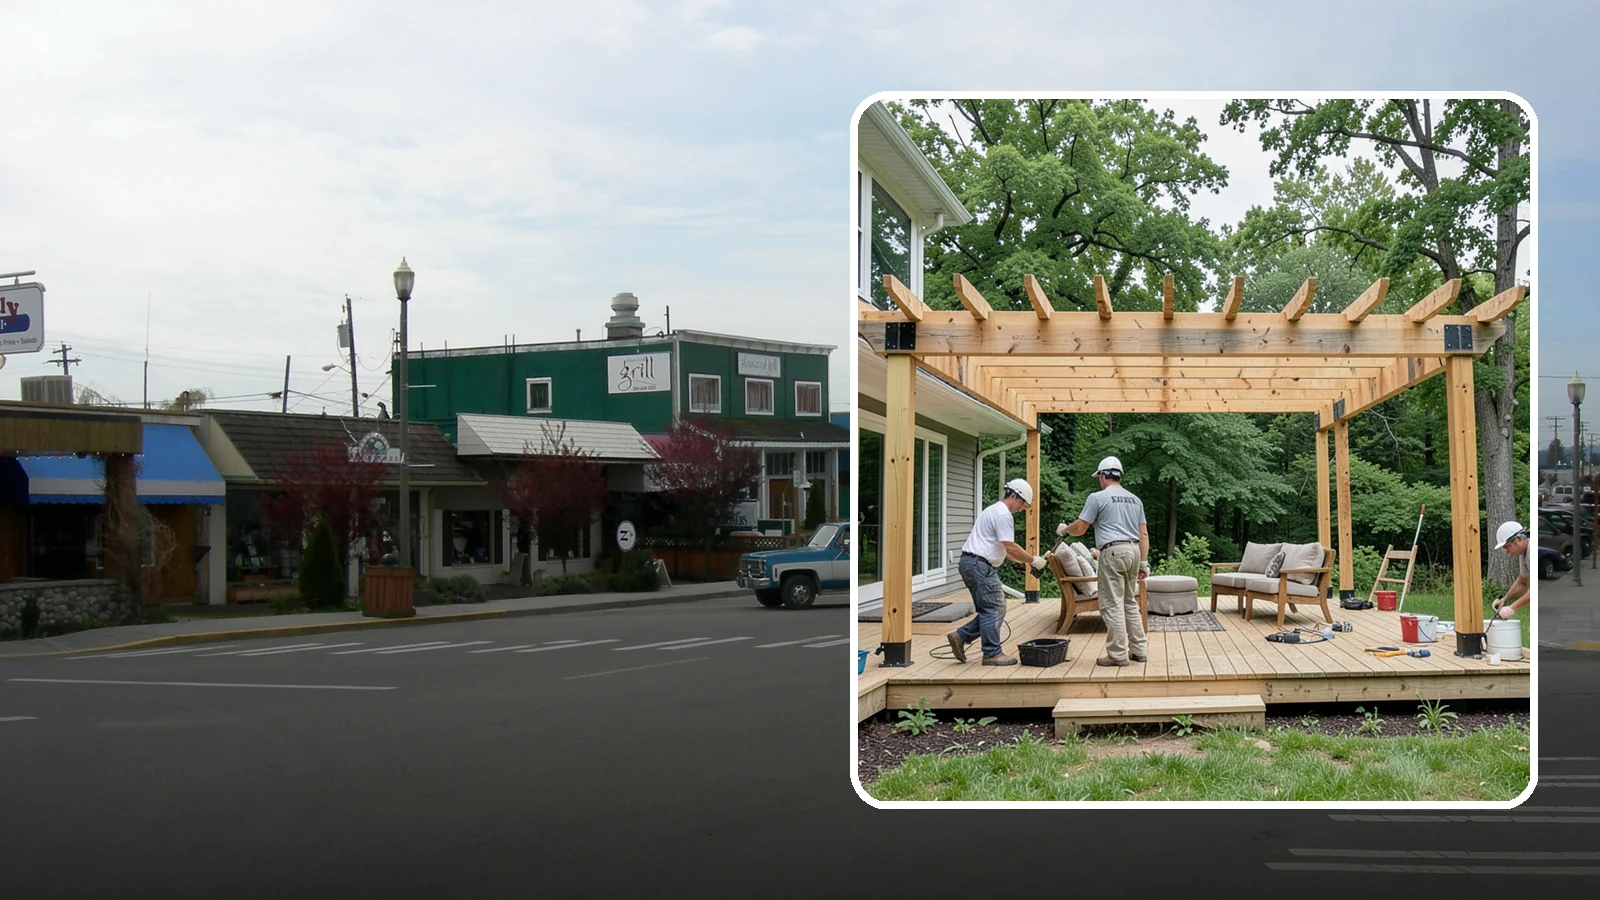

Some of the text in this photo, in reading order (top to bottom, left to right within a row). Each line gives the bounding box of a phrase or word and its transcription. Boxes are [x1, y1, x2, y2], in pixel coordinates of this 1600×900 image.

[3, 338, 16, 346] Fries
[20, 336, 38, 344] Salads
[617, 355, 655, 391] grill
